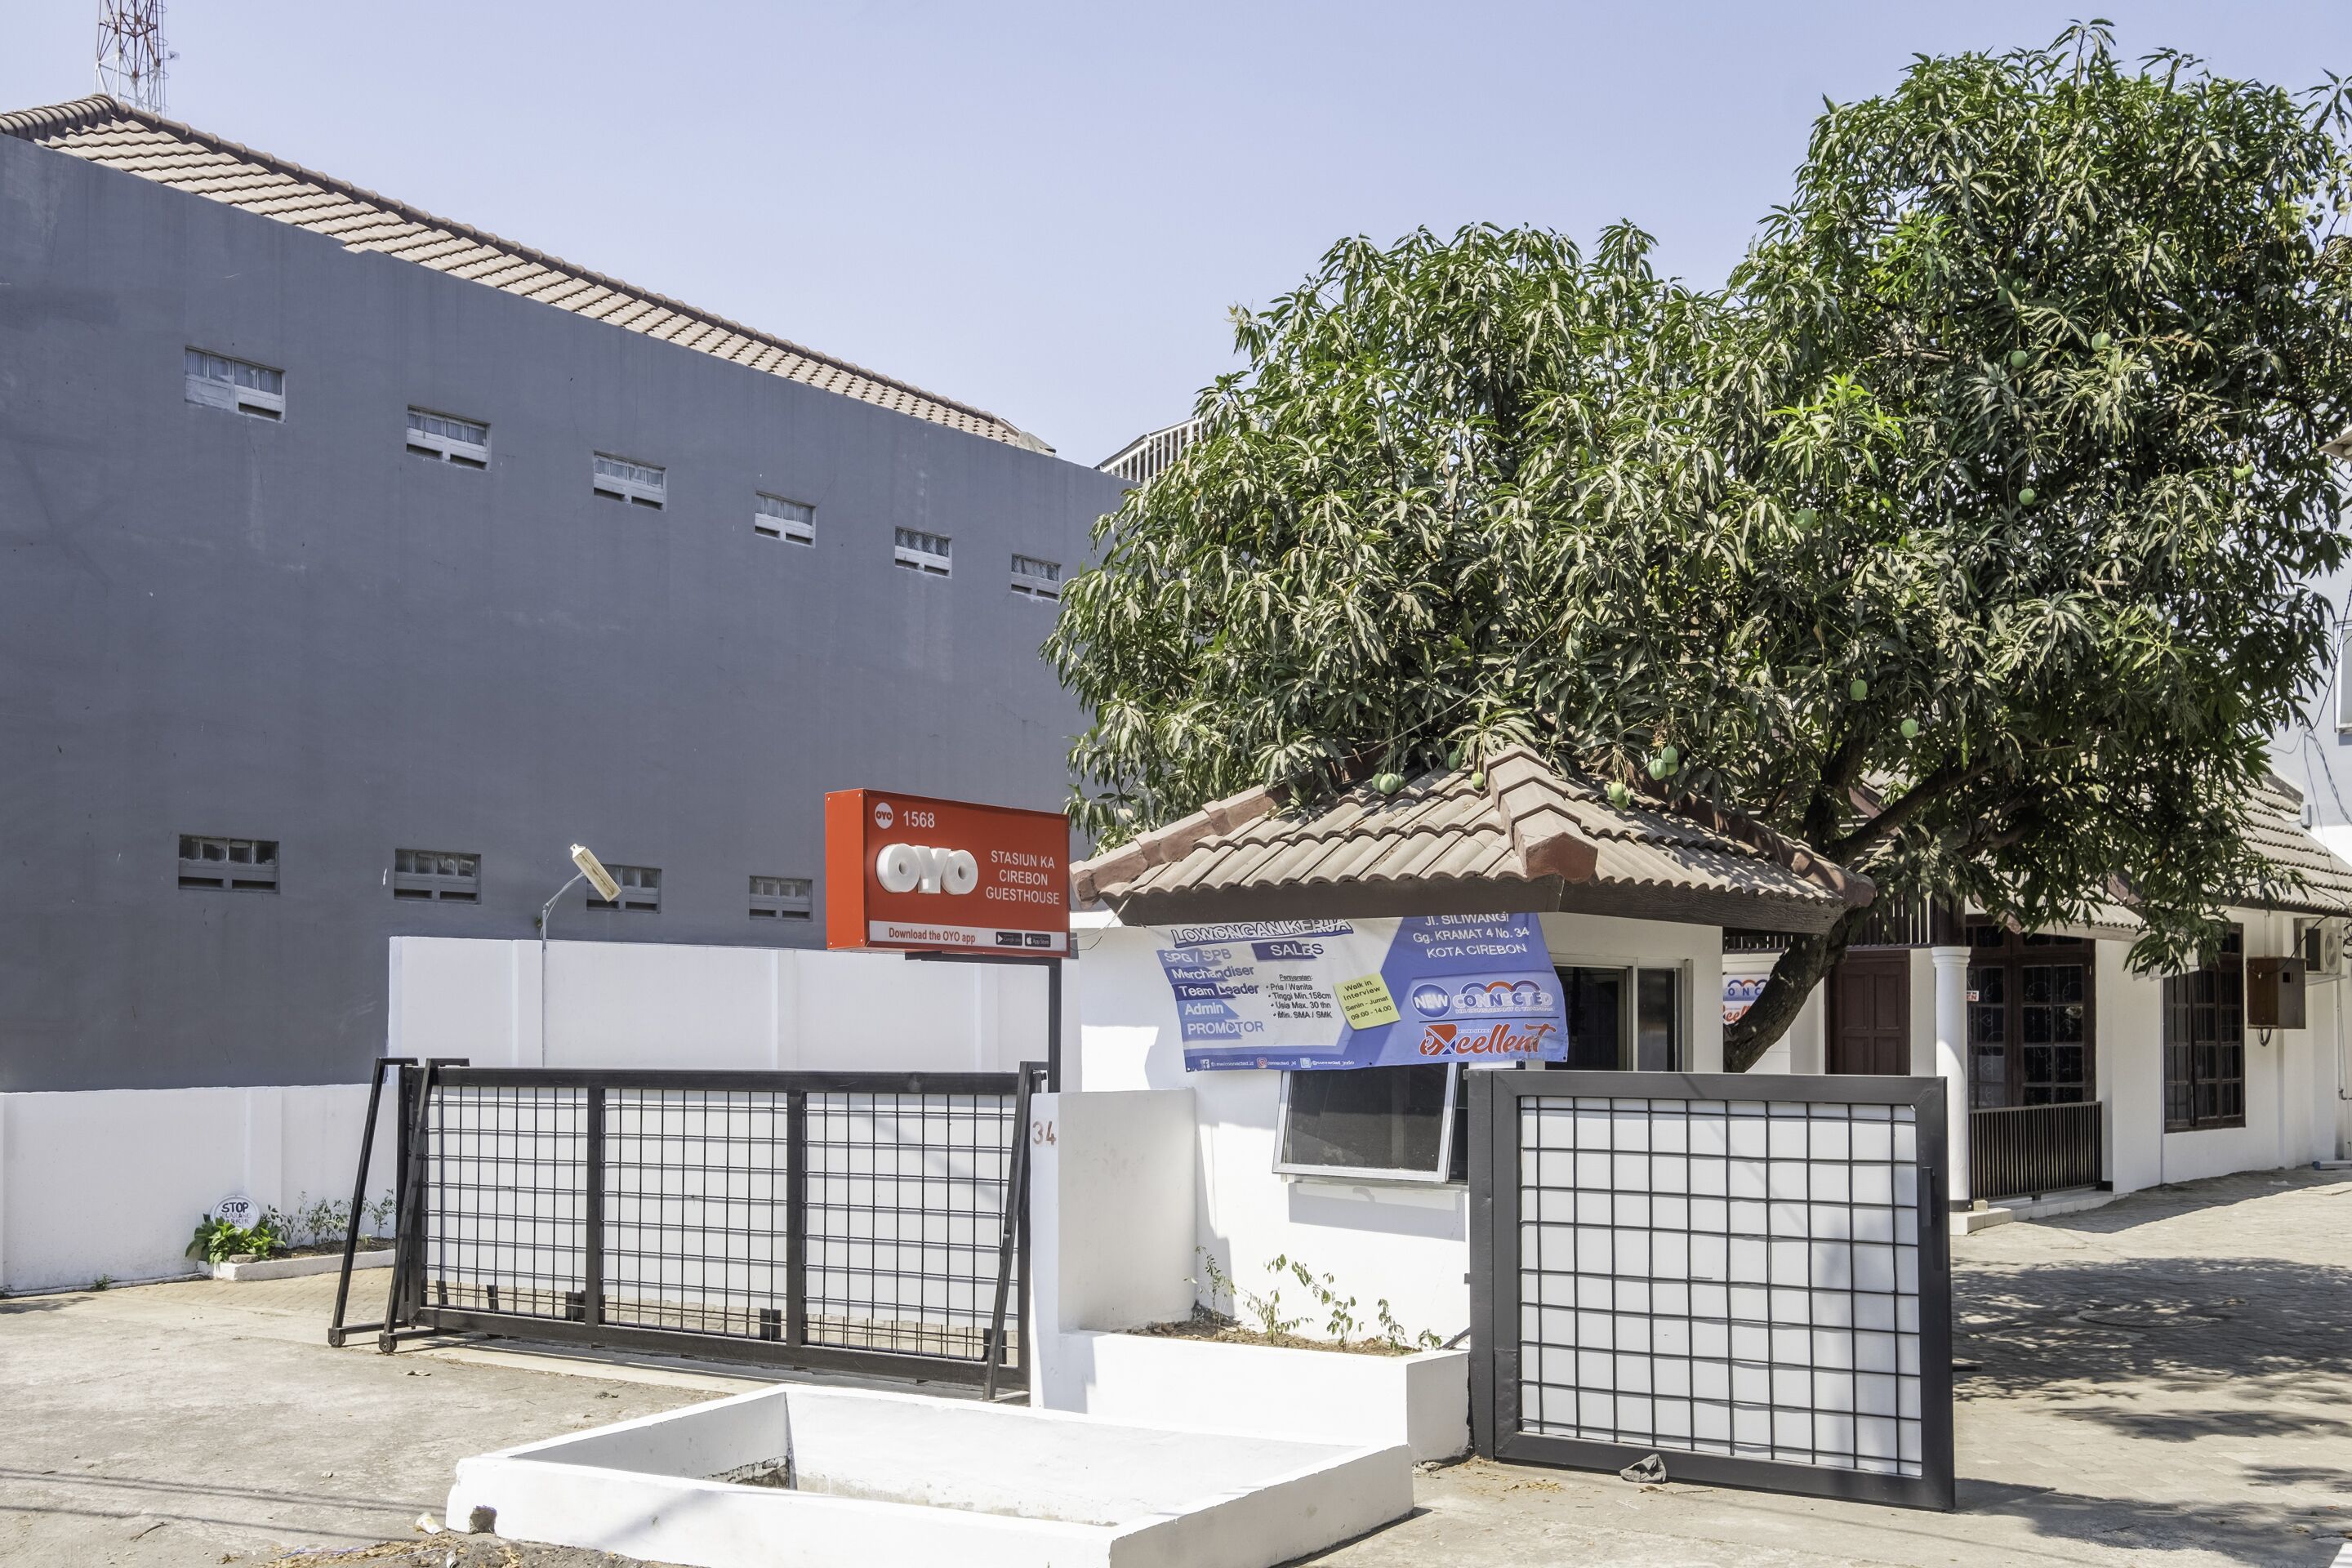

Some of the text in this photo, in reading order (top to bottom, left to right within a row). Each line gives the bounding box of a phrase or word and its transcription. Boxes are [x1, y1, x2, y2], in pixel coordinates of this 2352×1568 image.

[876, 811, 935, 828] OYO 1568
[991, 850, 1055, 868] STASIUN KA
[876, 843, 978, 895] OYO
[999, 869, 1048, 886] CIREBON
[986, 886, 1060, 905] GUESTHOUSE
[1441, 912, 1509, 925] SILIWANGI
[889, 927, 976, 945] Download the OYO app
[1413, 927, 1530, 944] Gg. KRAMAT 4 No. 34
[1164, 952, 1193, 963] SPG
[1202, 948, 1232, 961] SPB
[1270, 943, 1325, 957] SALES
[1426, 943, 1528, 959] KOTA CIREBON
[1171, 965, 1254, 980] Merchandiser
[1178, 982, 1259, 996] Team Leader
[1343, 986, 1381, 1001] Interview
[1344, 982, 1365, 992] Walk
[1272, 992, 1294, 1001] Tinggi
[1345, 1002, 1365, 1012] Senin
[1370, 996, 1390, 1005] Jumat
[1414, 993, 1449, 1009] NEW
[1453, 991, 1552, 1009] CONNECTED
[1184, 1002, 1224, 1015] Admin
[1351, 1010, 1370, 1021] 09.00
[1374, 1005, 1392, 1014] 14.00
[1187, 1021, 1264, 1036] PROMOTOR
[1032, 1120, 1057, 1145] 34
[221, 1201, 249, 1213] STOP
